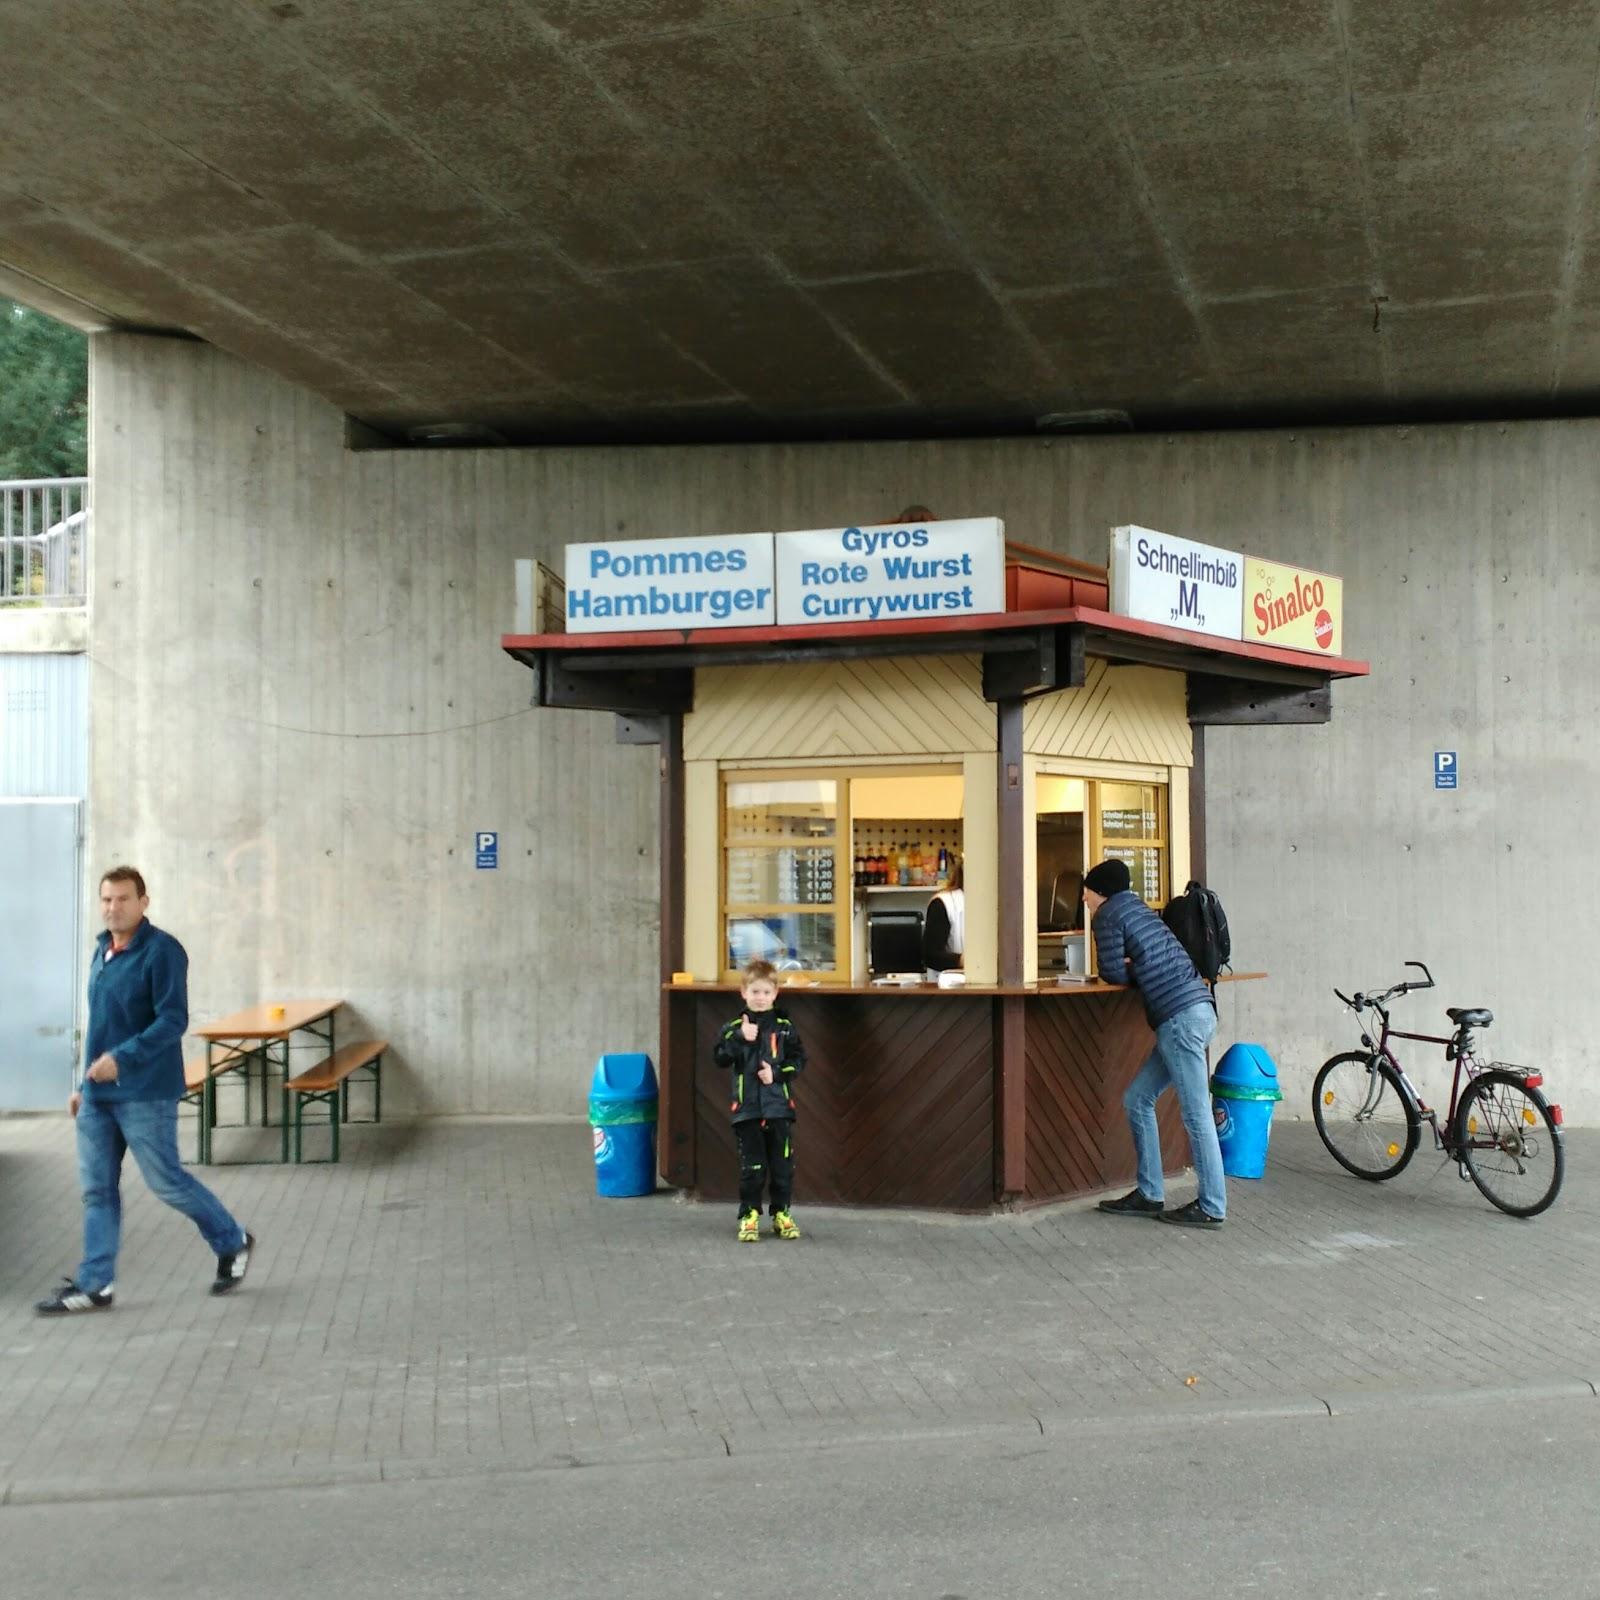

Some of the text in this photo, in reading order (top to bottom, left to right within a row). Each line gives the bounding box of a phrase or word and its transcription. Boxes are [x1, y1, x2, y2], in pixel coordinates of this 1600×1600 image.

[841, 527, 929, 555] Gyros
[589, 548, 747, 578] Pommes
[801, 552, 972, 586] Rote Wurst
[1137, 538, 1237, 588] Schnellimbiß
[568, 585, 770, 619] Hamburger
[801, 585, 973, 619] Currywurst
[1253, 575, 1324, 636] Sinalco
[1438, 753, 1453, 771] P
[479, 833, 495, 852] P
